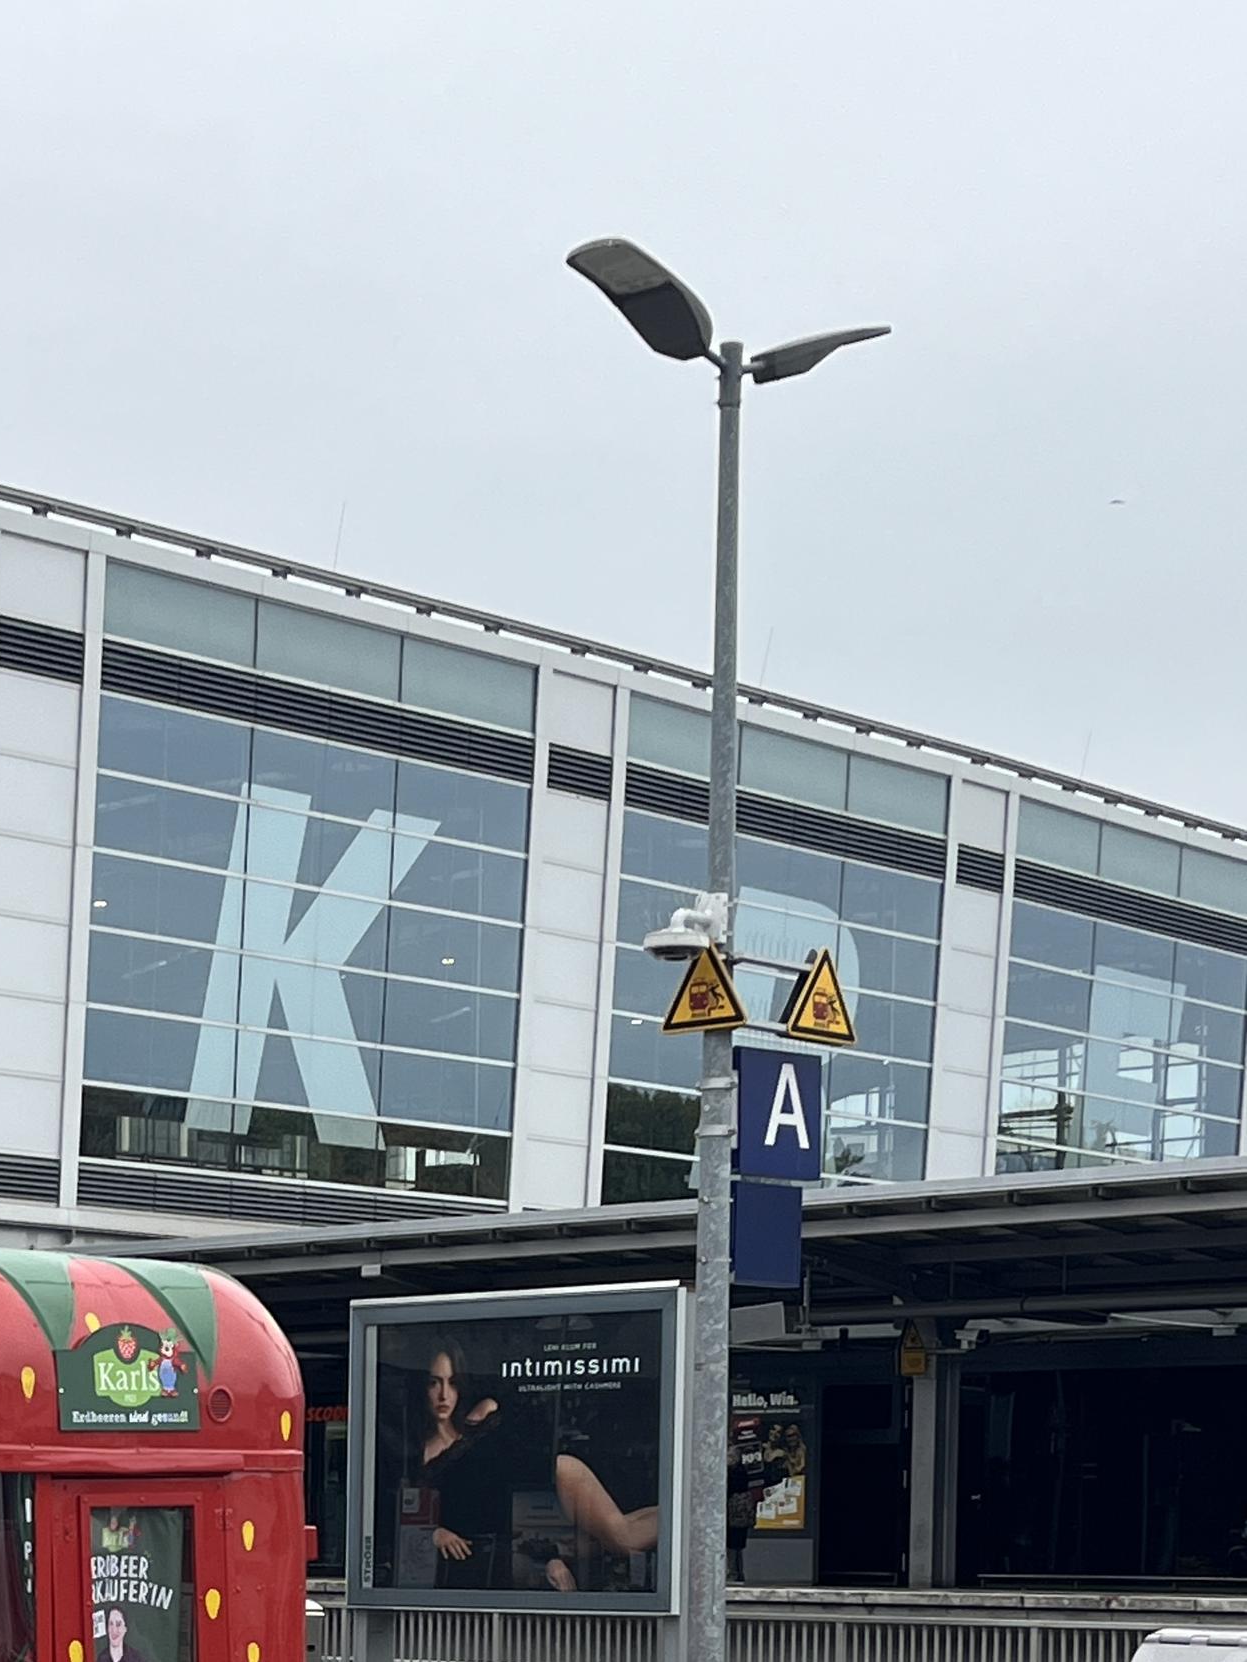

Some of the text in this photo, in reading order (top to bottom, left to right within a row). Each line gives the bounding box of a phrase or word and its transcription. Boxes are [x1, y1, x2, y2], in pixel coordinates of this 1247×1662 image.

[185, 782, 441, 1152] K
[764, 1062, 810, 1149] A
[98, 1361, 160, 1391] Karls
[502, 1357, 640, 1378] intimissimi
[732, 1392, 768, 1409] Hello,
[72, 1410, 127, 1423] Erdbeeren
